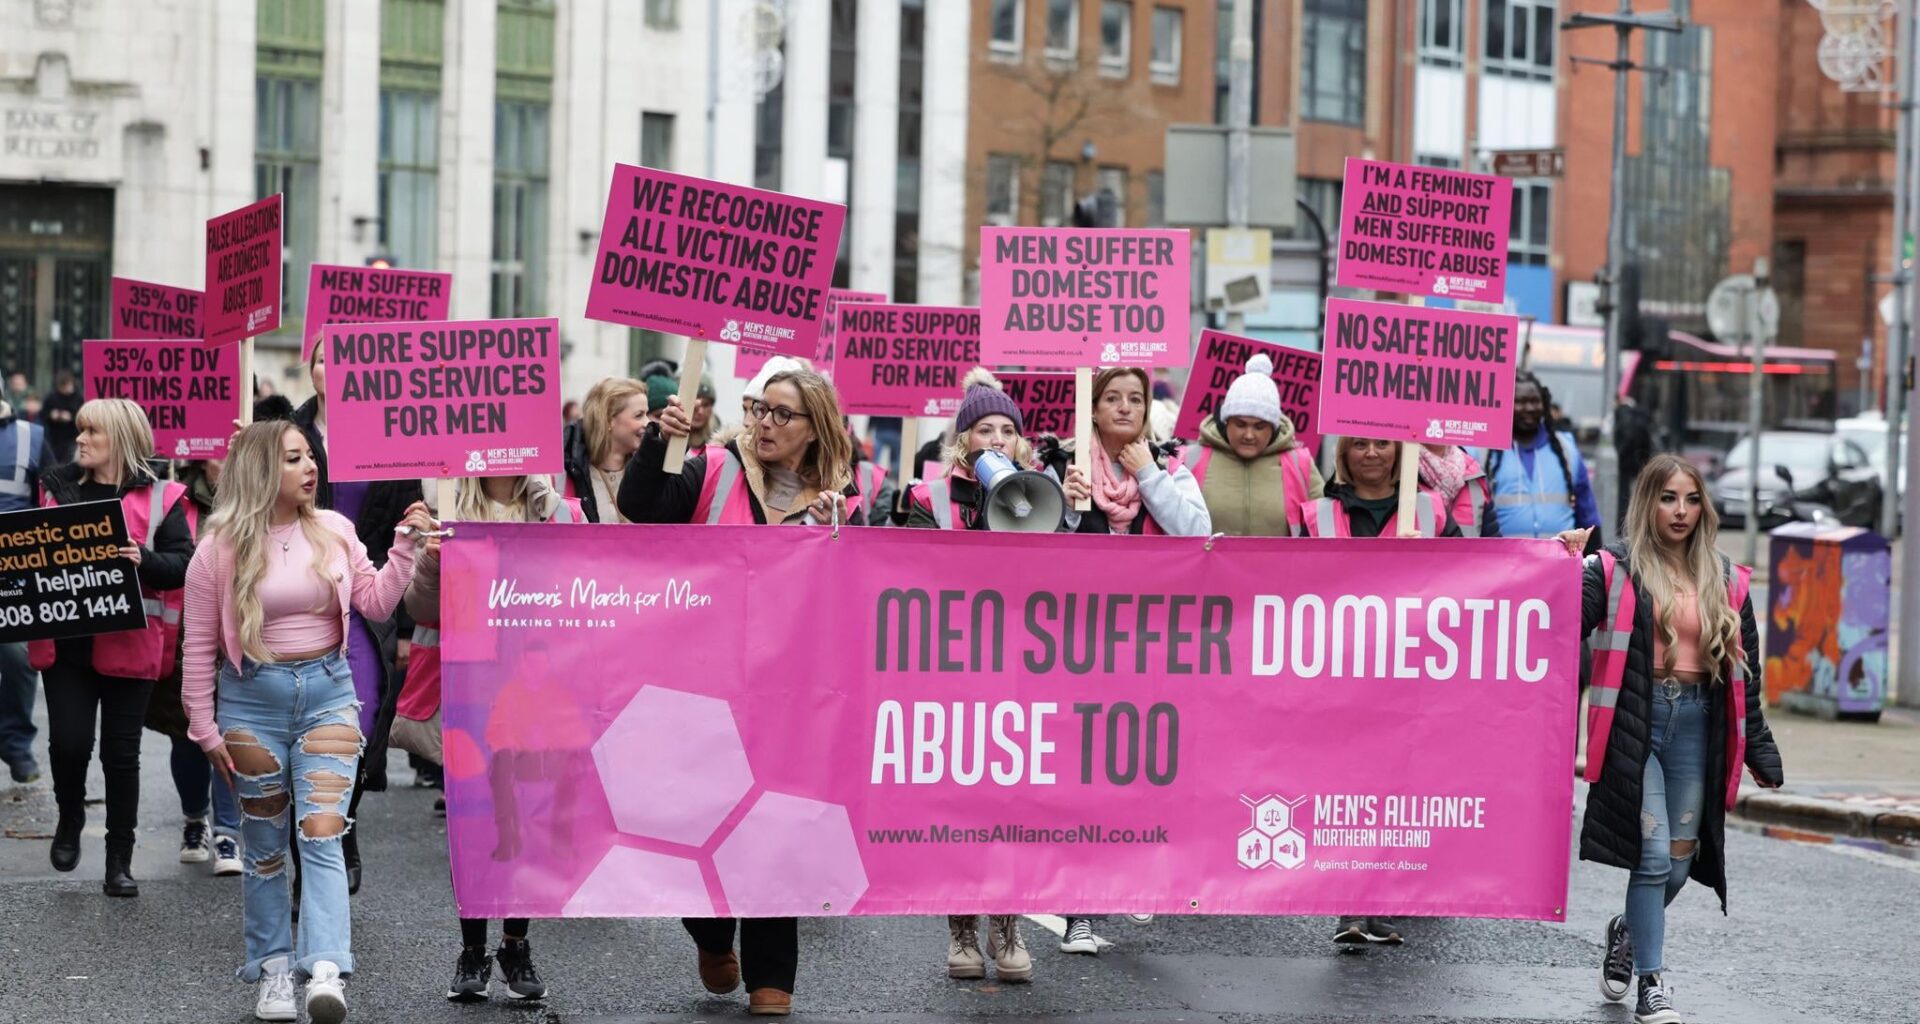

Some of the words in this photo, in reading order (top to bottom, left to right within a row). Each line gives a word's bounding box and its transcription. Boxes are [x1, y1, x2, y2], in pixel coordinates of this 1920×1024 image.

[1362, 165, 1390, 187] I'M
[1394, 170, 1407, 189] A
[1411, 171, 1495, 200] FEMINIST
[633, 175, 677, 215] WE
[679, 186, 823, 243] RECOGNISE
[1362, 191, 1402, 215] AND
[1406, 197, 1490, 225] SUPPORT
[207, 220, 230, 254] FALSE
[231, 202, 279, 246] ALLEGATIONS
[1354, 215, 1393, 239] MEN
[1397, 221, 1495, 251] SUFFERING
[217, 253, 233, 284] ARE
[234, 239, 271, 277] DOMESTIC
[620, 216, 667, 254] ALL
[676, 224, 779, 274] VICTIMS
[782, 245, 817, 280] OF
[996, 235, 1057, 264] MEN
[1065, 236, 1174, 266] SUFFER
[1345, 240, 1436, 270] DOMESTIC
[1439, 252, 1500, 277] ABUSE
[129, 285, 172, 310] 35%
[176, 294, 198, 314] OF
[222, 281, 247, 315] ABUSE
[250, 275, 263, 305] TOO
[321, 270, 364, 292] MEN
[368, 273, 442, 298] SUFFER
[601, 251, 731, 305] DOMESTIC
[732, 276, 822, 322] ABUSE
[1012, 269, 1159, 299] DOMESTIC
[120, 307, 195, 338] VICTIMS
[329, 295, 429, 321] DOMESTIC
[841, 310, 892, 334] MORE
[901, 313, 980, 336] SUPPOR
[1004, 303, 1102, 332] ABUSE
[1109, 304, 1165, 333] TOO
[333, 331, 413, 365] MORE
[420, 326, 552, 362] SUPPORT
[844, 337, 888, 359] AND
[1336, 312, 1369, 350] NO
[1372, 316, 1430, 356] SAFE
[1432, 322, 1509, 363] HOUSE
[104, 348, 153, 372] 35%
[158, 348, 185, 372] OF
[191, 347, 220, 371] DV
[94, 376, 182, 400] VICTIMS
[188, 376, 231, 400] ARE
[341, 368, 402, 402] AND
[409, 363, 546, 400] SERVICES
[871, 364, 911, 387] FOR
[914, 366, 957, 388] MEN
[1335, 358, 1379, 397] FOR
[1383, 362, 1433, 402] MEN
[1436, 367, 1461, 405] IN
[1464, 370, 1501, 408] N.I.
[384, 404, 439, 437] FOR
[446, 402, 507, 435] MEN
[69, 515, 114, 540] and
[53, 543, 120, 566] abuse
[35, 565, 124, 596] helpline
[571, 577, 629, 610] March
[634, 591, 661, 615] for
[665, 578, 711, 610] Men
[39, 600, 80, 623] 802
[83, 593, 131, 618] 1414
[488, 618, 552, 628] BREAKING
[558, 618, 581, 628] THE
[587, 618, 616, 628] BIAS
[875, 587, 1005, 673] MEN
[1023, 590, 1234, 675] SUFFER
[1251, 594, 1551, 682] DOMESTIC
[870, 699, 1058, 786] ABUSE
[1073, 702, 1180, 786] TOO
[1313, 794, 1377, 826] MEN'S
[867, 824, 1169, 845] www.MensAllianceNI.co.uk
[1312, 829, 1377, 847] NORTHERN
[1380, 829, 1431, 848] IRELAND
[1313, 859, 1349, 872] Against
[1351, 860, 1395, 871] Domestic
[1398, 861, 1428, 871] Abuse
